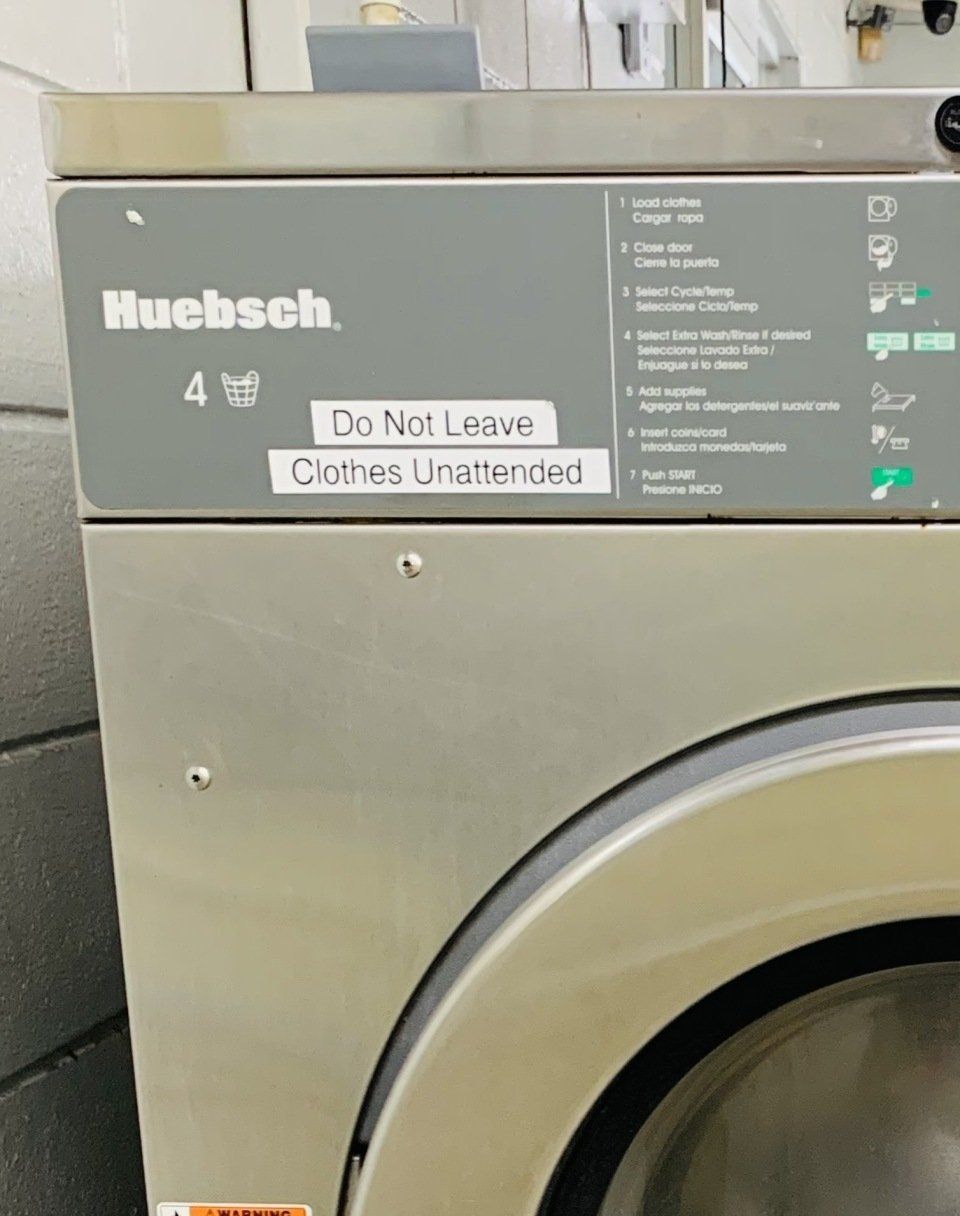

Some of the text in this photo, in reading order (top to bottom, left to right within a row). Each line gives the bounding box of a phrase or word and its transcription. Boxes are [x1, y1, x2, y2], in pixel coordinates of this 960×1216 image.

[620, 197, 702, 208] 1 Load clothes
[633, 212, 704, 225] Cargar ropa
[621, 242, 693, 253] 2 Close door
[634, 257, 720, 270] Cierre la puerta
[622, 286, 735, 298] 3 Select Cycle/Temp
[102, 289, 332, 330] Huebsch
[635, 301, 759, 313] Seleccione Ciclo/Temp
[623, 330, 812, 342] 4 Select Extra Wash/Rinse if desired
[637, 345, 697, 356] Seleccione
[699, 345, 741, 356] Lavado
[742, 345, 769, 356] Extra
[637, 359, 689, 372] Enjuague
[700, 359, 712, 371] lo
[713, 359, 749, 371] desea
[183, 371, 208, 407] 4
[625, 386, 707, 399] 5 Add supplies
[639, 401, 683, 414] Agregar
[685, 401, 700, 412] los
[702, 401, 780, 415] detergentes/el
[332, 410, 535, 436] Do Not Leave
[627, 427, 728, 439] 6 Insert coins/card
[640, 442, 788, 455] Introduzca monedas/tarjeta
[291, 457, 582, 485] Clothes Unattended
[630, 470, 696, 481] 7 Push START
[642, 484, 723, 496] Presione INICIO
